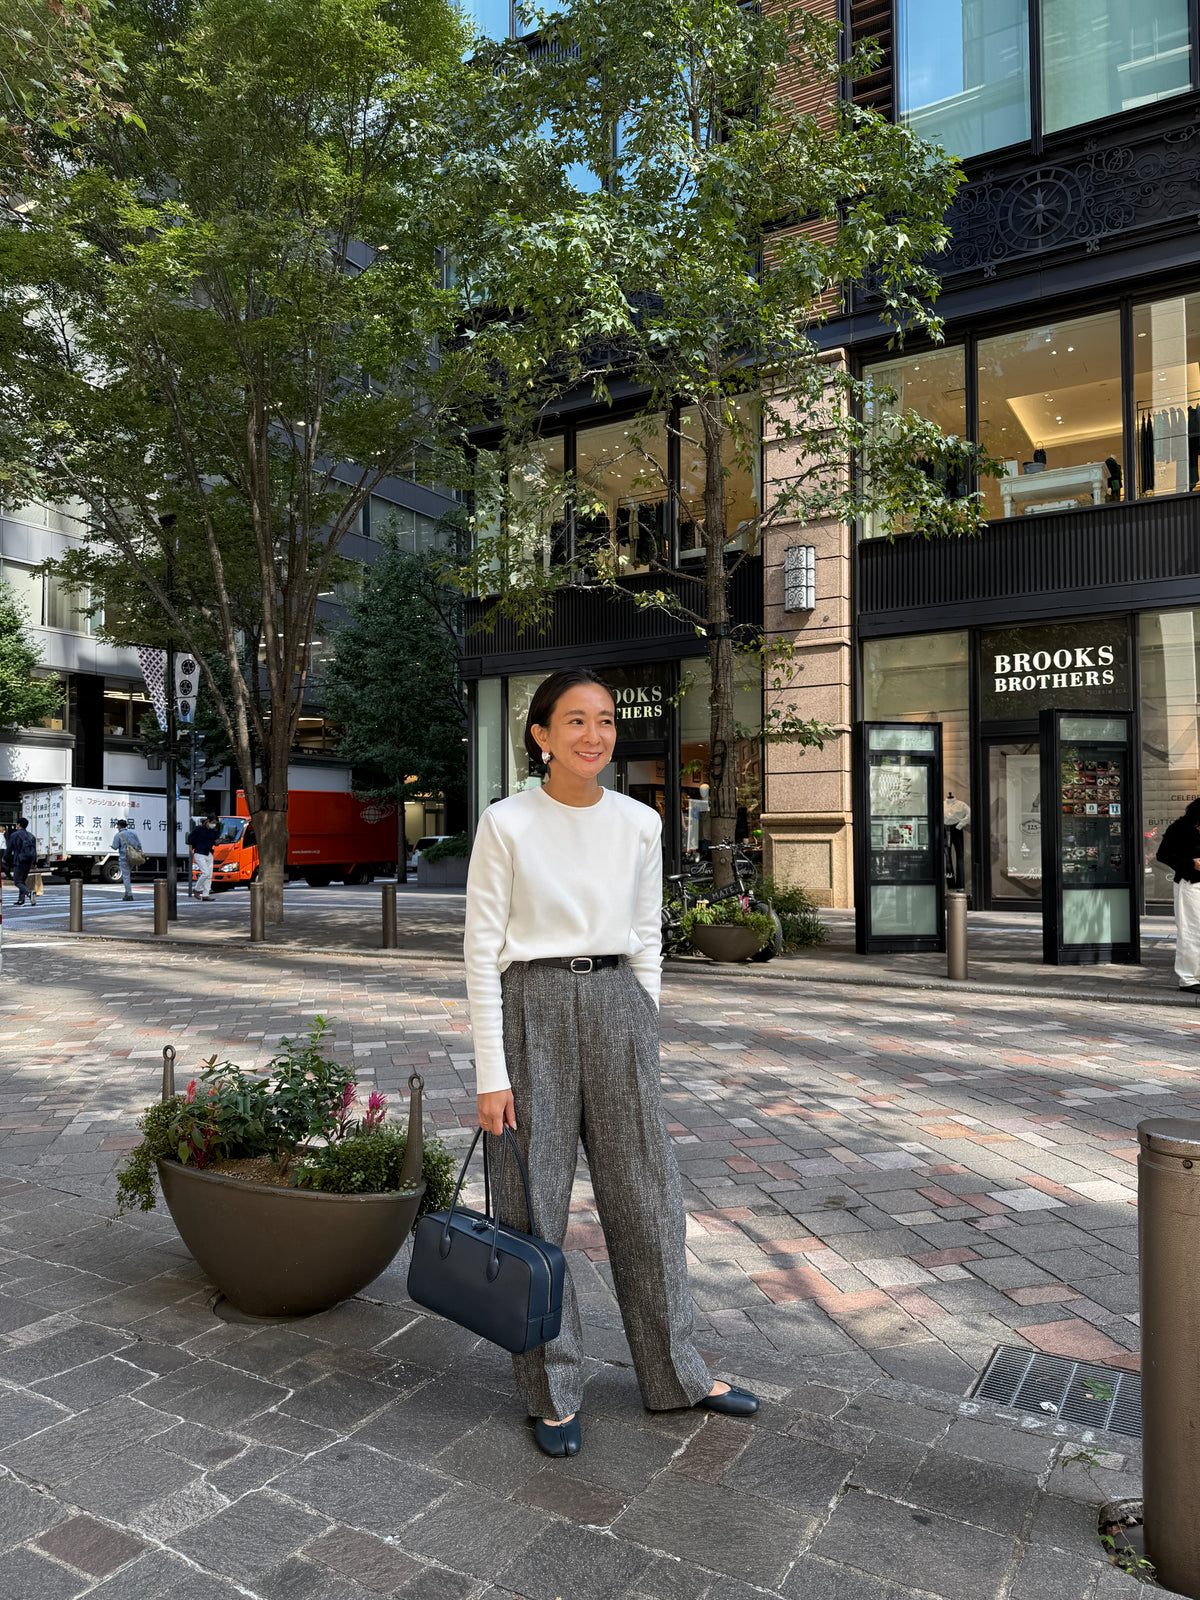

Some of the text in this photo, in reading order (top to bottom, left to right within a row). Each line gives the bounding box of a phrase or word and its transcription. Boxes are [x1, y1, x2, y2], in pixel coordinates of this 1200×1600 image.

[994, 645, 1114, 674] BROOKS
[994, 669, 1115, 692] BROTHERS
[612, 685, 662, 704] OOKS
[616, 704, 662, 719] HERS
